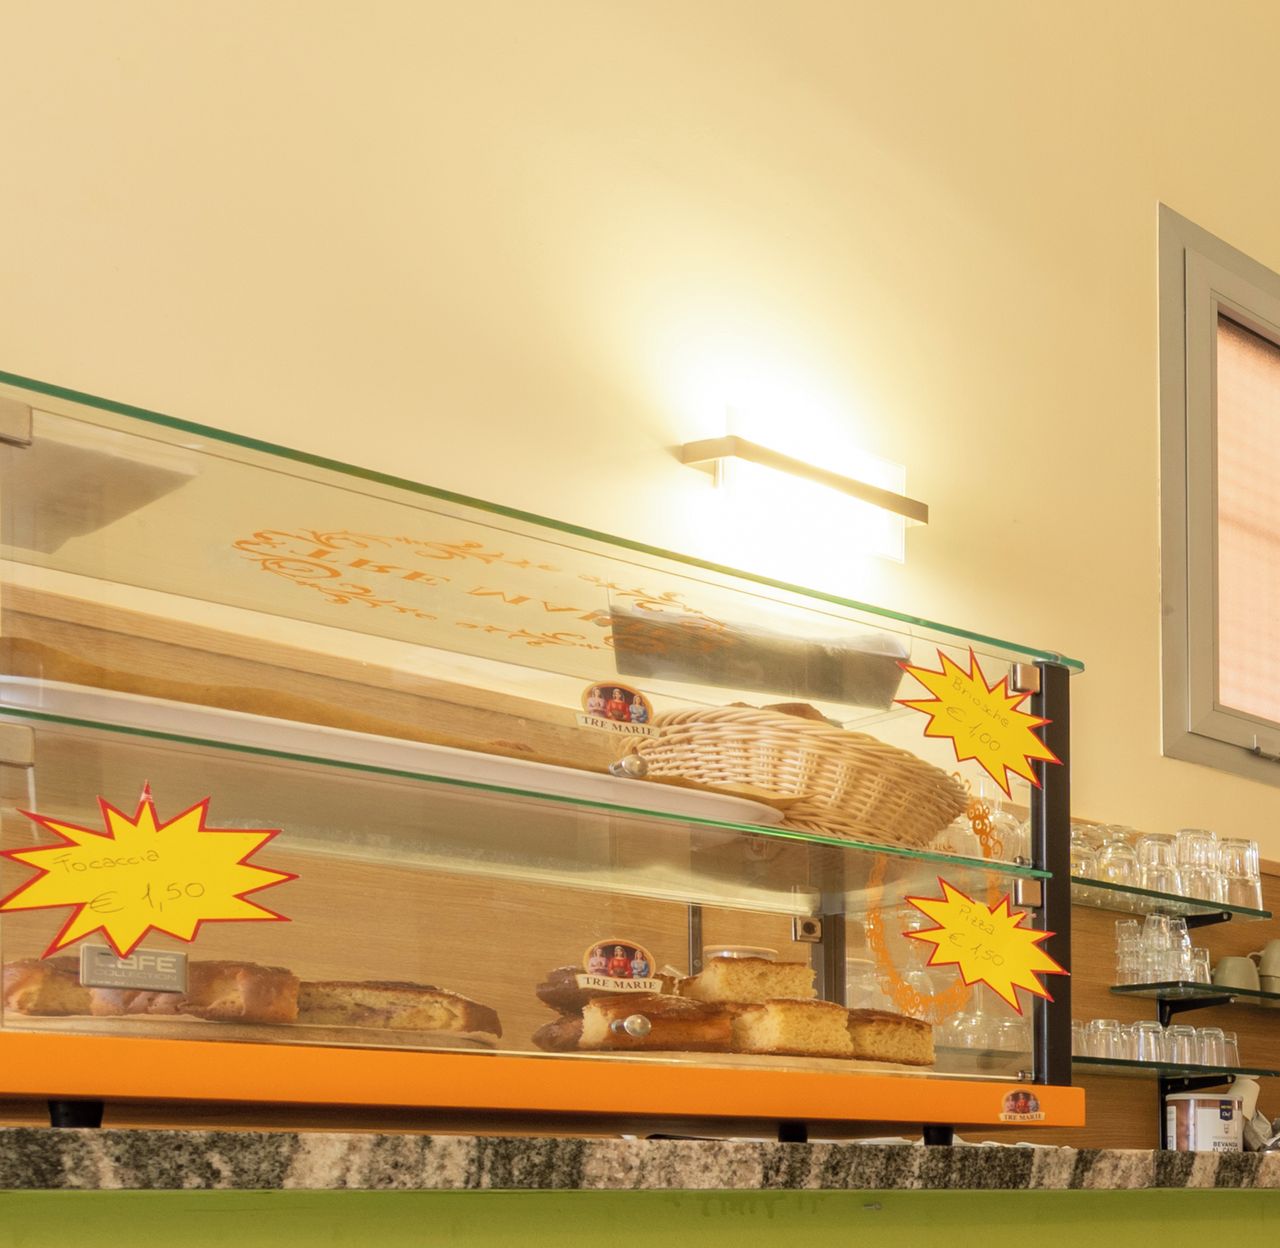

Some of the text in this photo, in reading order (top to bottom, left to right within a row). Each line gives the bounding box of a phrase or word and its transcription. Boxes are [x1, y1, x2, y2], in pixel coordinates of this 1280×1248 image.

[582, 716, 653, 736] TRE MARIE
[53, 850, 159, 873] Focaccia
[88, 882, 205, 913] € 1,50
[960, 904, 995, 935] Pizza
[970, 943, 1005, 966] 1,50
[585, 976, 656, 989] TRE MARIE
